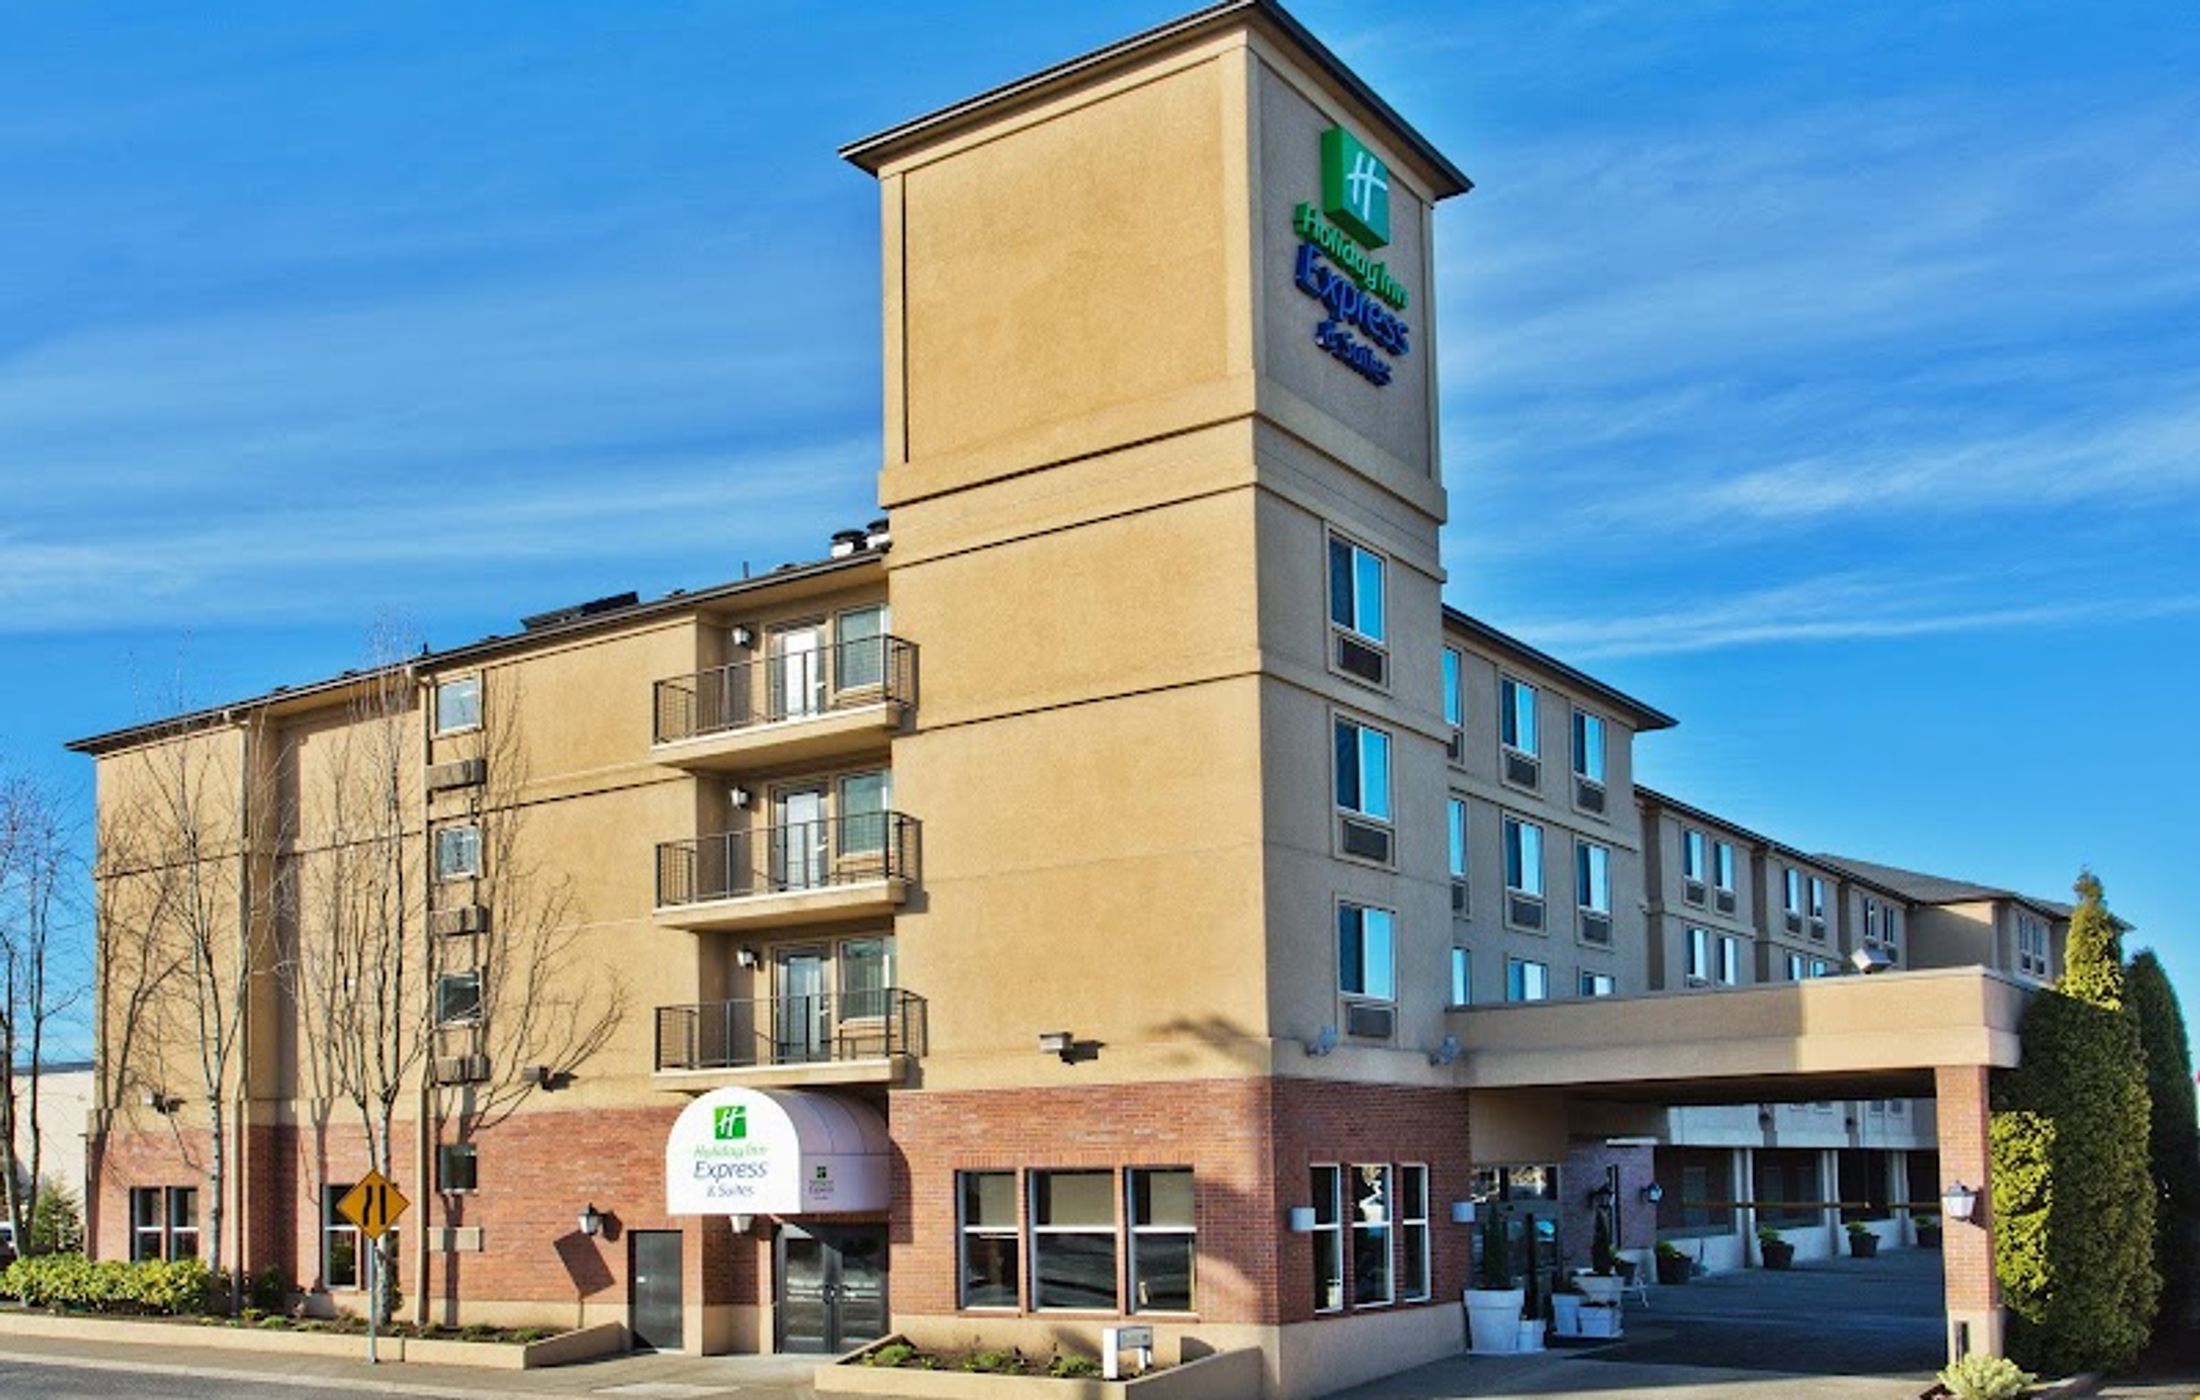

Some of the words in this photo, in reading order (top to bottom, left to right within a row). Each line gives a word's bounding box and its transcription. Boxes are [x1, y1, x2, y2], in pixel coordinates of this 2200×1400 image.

[1294, 203, 1377, 291] Holiday
[1376, 261, 1409, 311] Inn
[1295, 241, 1409, 355] Express
[694, 1144, 744, 1159] Holiday
[745, 1143, 769, 1157] Inn
[693, 1160, 769, 1184] Express
[718, 1183, 756, 1198] Suites
